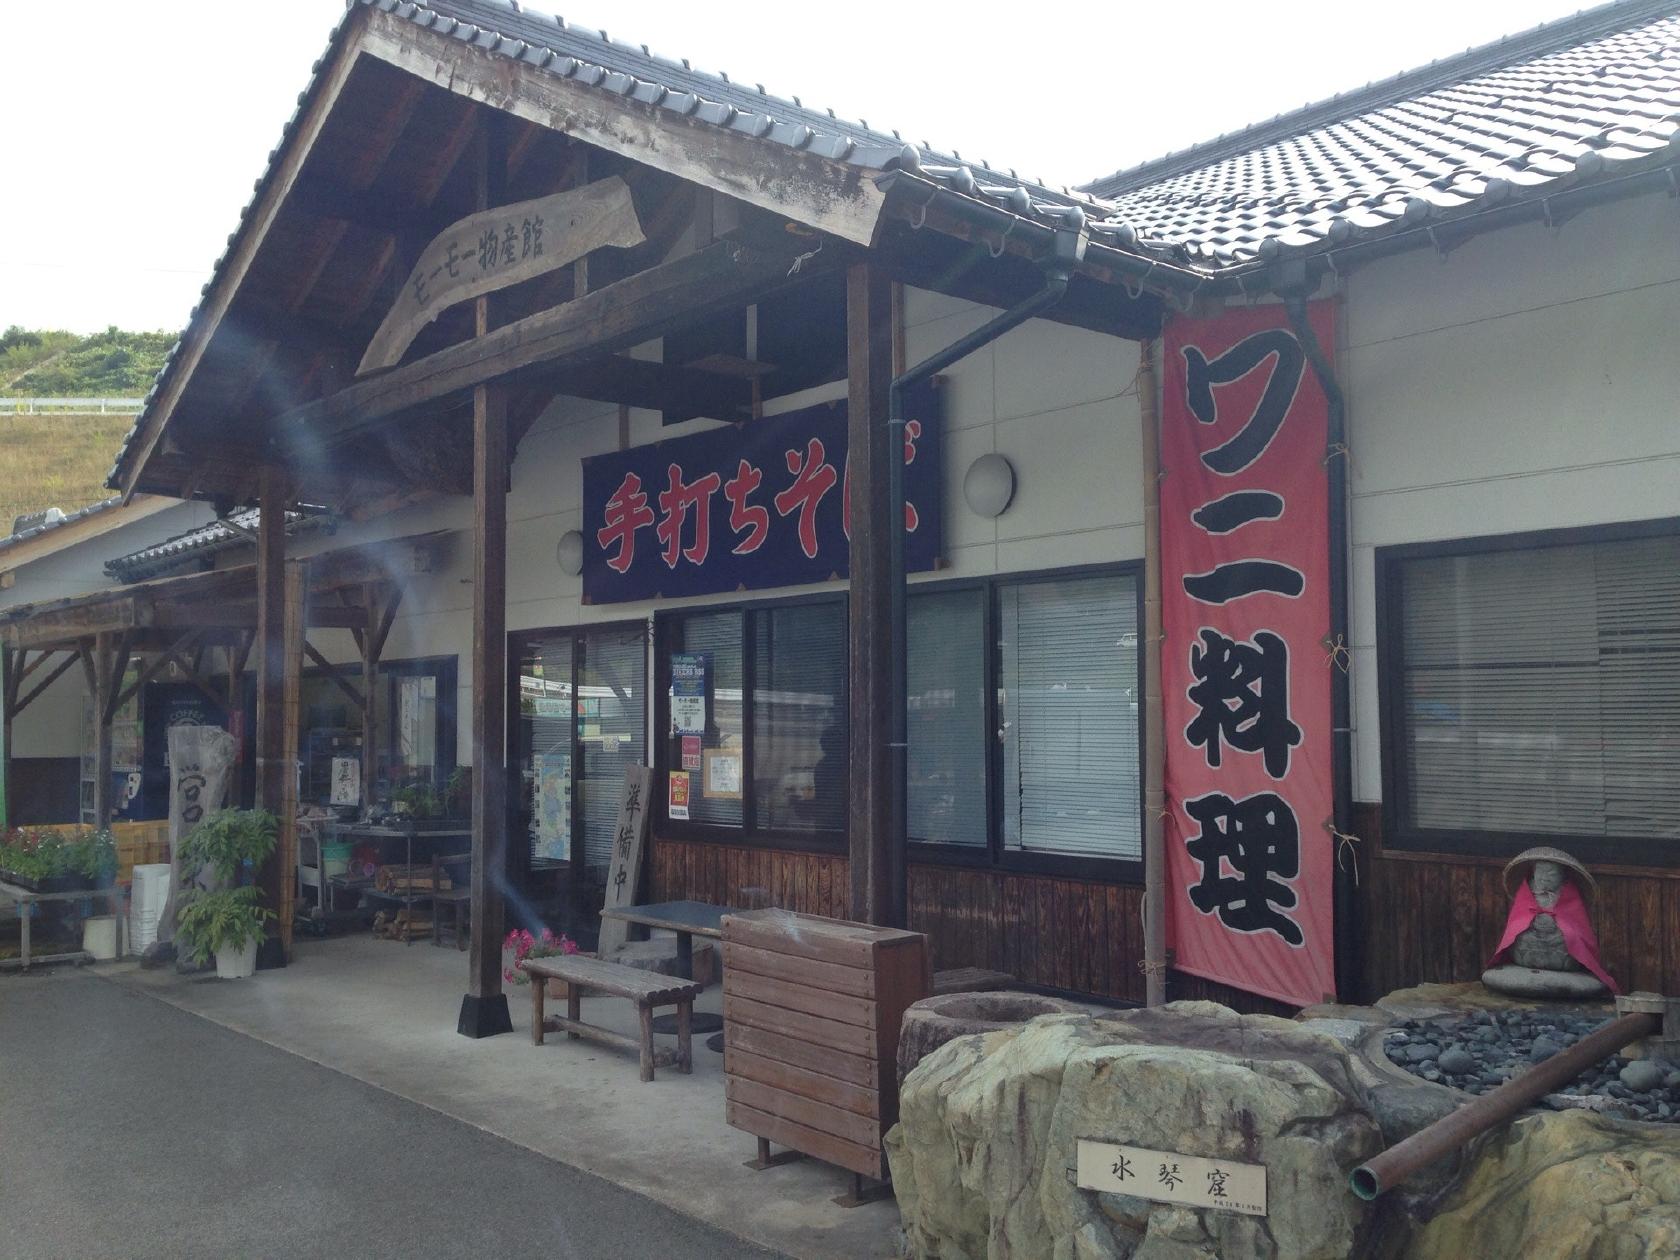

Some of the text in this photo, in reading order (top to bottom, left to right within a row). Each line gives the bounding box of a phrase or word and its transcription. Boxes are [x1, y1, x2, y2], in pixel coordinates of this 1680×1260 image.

[413, 214, 544, 305] モーモー物産館
[1183, 329, 1306, 948] ワニ料理
[614, 783, 641, 901] 準備中
[1111, 1155, 1230, 1198] 水琴窟
